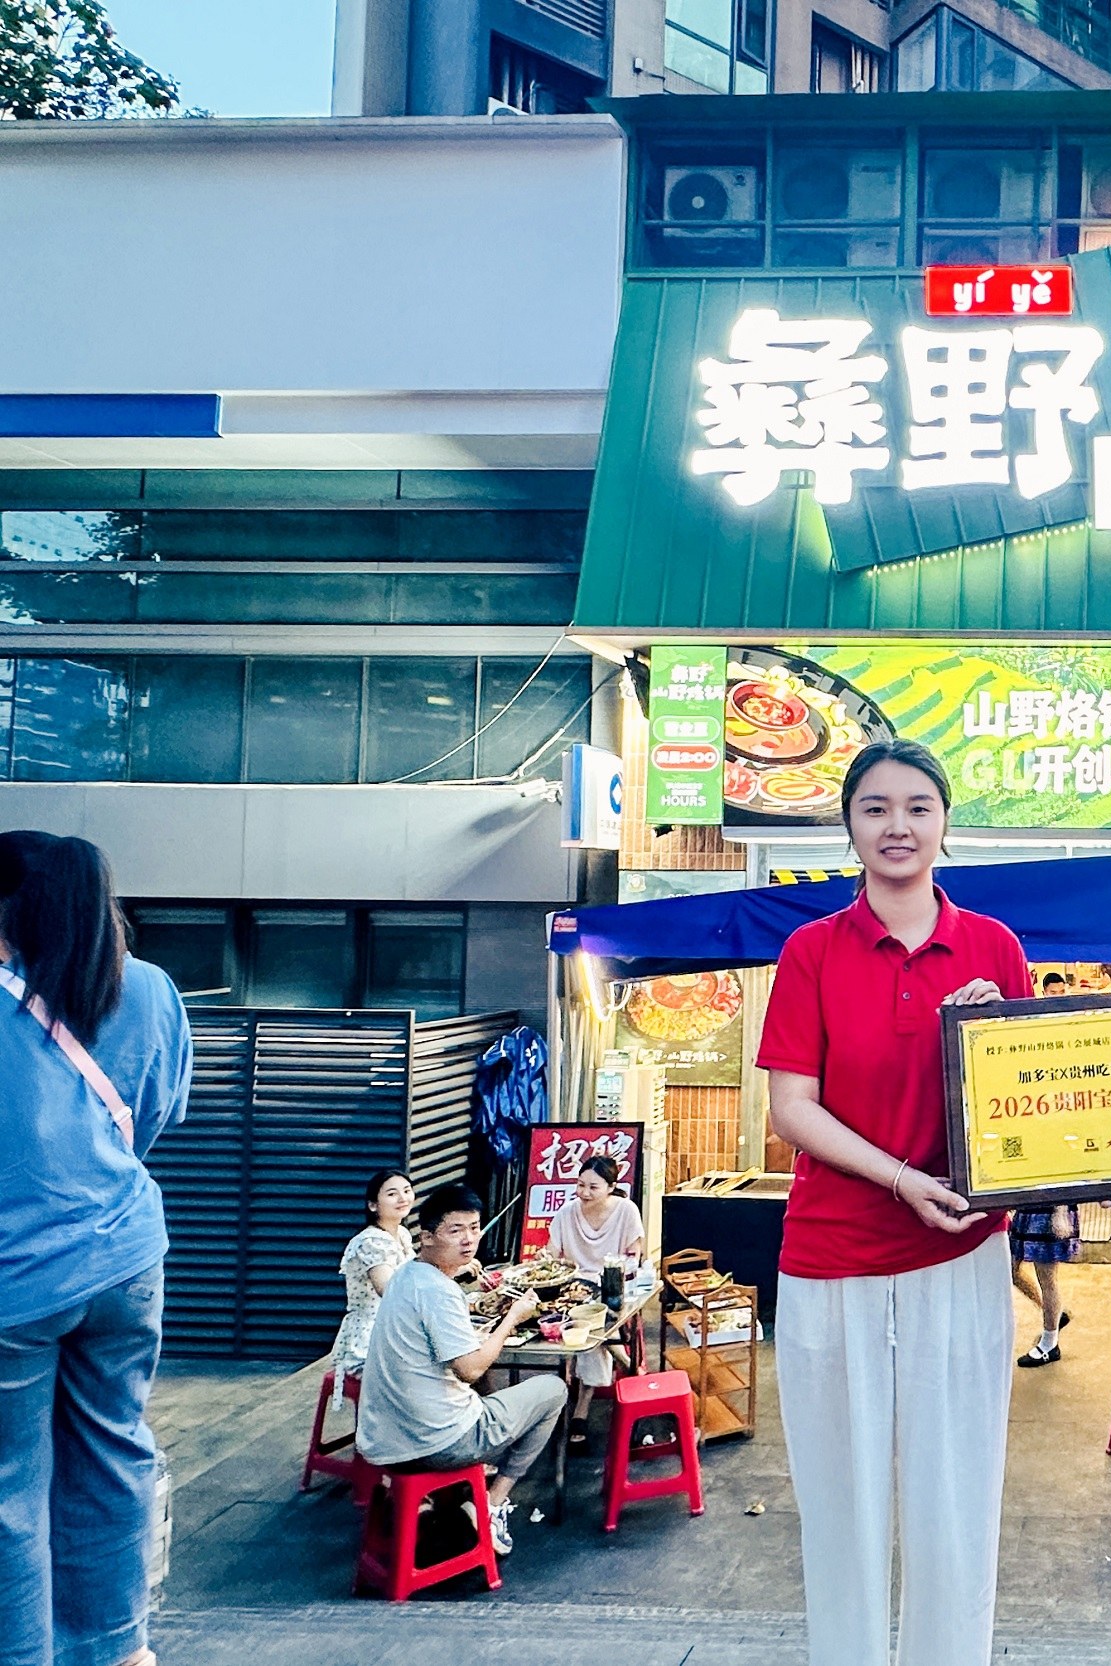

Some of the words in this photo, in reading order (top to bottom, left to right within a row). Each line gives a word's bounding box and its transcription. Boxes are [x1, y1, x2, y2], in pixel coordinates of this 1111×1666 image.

[953, 269, 995, 312] yí
[1011, 269, 1054, 313] yě
[691, 308, 1105, 507] 彝野
[661, 795, 707, 807] HOURS
